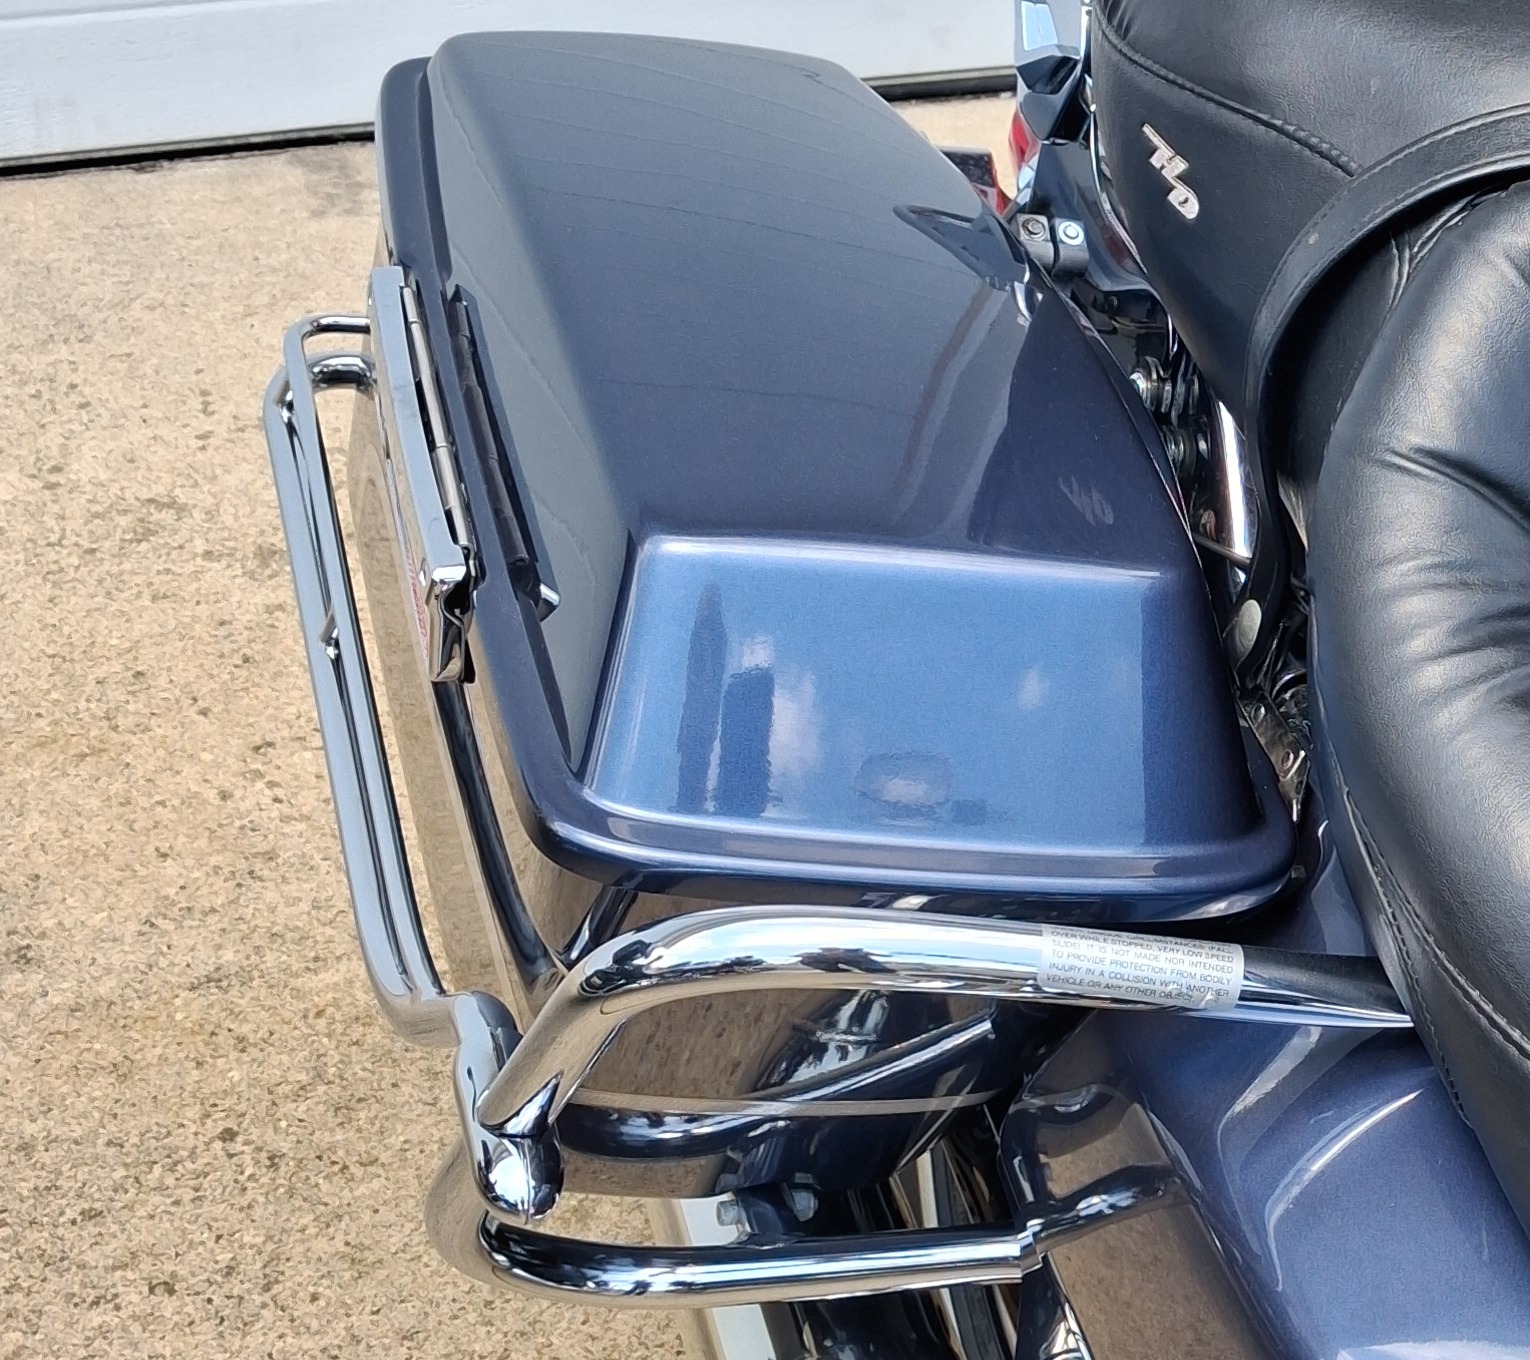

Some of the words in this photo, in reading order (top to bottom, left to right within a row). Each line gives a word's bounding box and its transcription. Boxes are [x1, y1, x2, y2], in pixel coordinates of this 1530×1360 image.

[1051, 930, 1077, 940] OVER
[1079, 934, 1109, 944] WHILE
[1157, 945, 1180, 955] VERY
[1182, 949, 1203, 958] LOW
[1052, 949, 1064, 959] TO
[1067, 952, 1107, 966] PROVIDE
[1110, 958, 1168, 976] PROTECTION
[1170, 968, 1197, 981] FROM
[1200, 973, 1232, 986] BODILY
[1111, 947, 1130, 957] NOT
[1134, 952, 1161, 962] MADE
[1165, 956, 1185, 966] NOR
[1188, 961, 1234, 974] INTENDED
[1046, 973, 1085, 987] VEHICLE
[1087, 980, 1101, 989] OR
[1103, 982, 1124, 992] ANY
[1125, 985, 1156, 997] OTHER
[1048, 962, 1082, 973] INJURY
[1085, 967, 1096, 976] IN
[1108, 971, 1157, 986] COLLISION
[1185, 982, 1229, 997] ANOTHER
